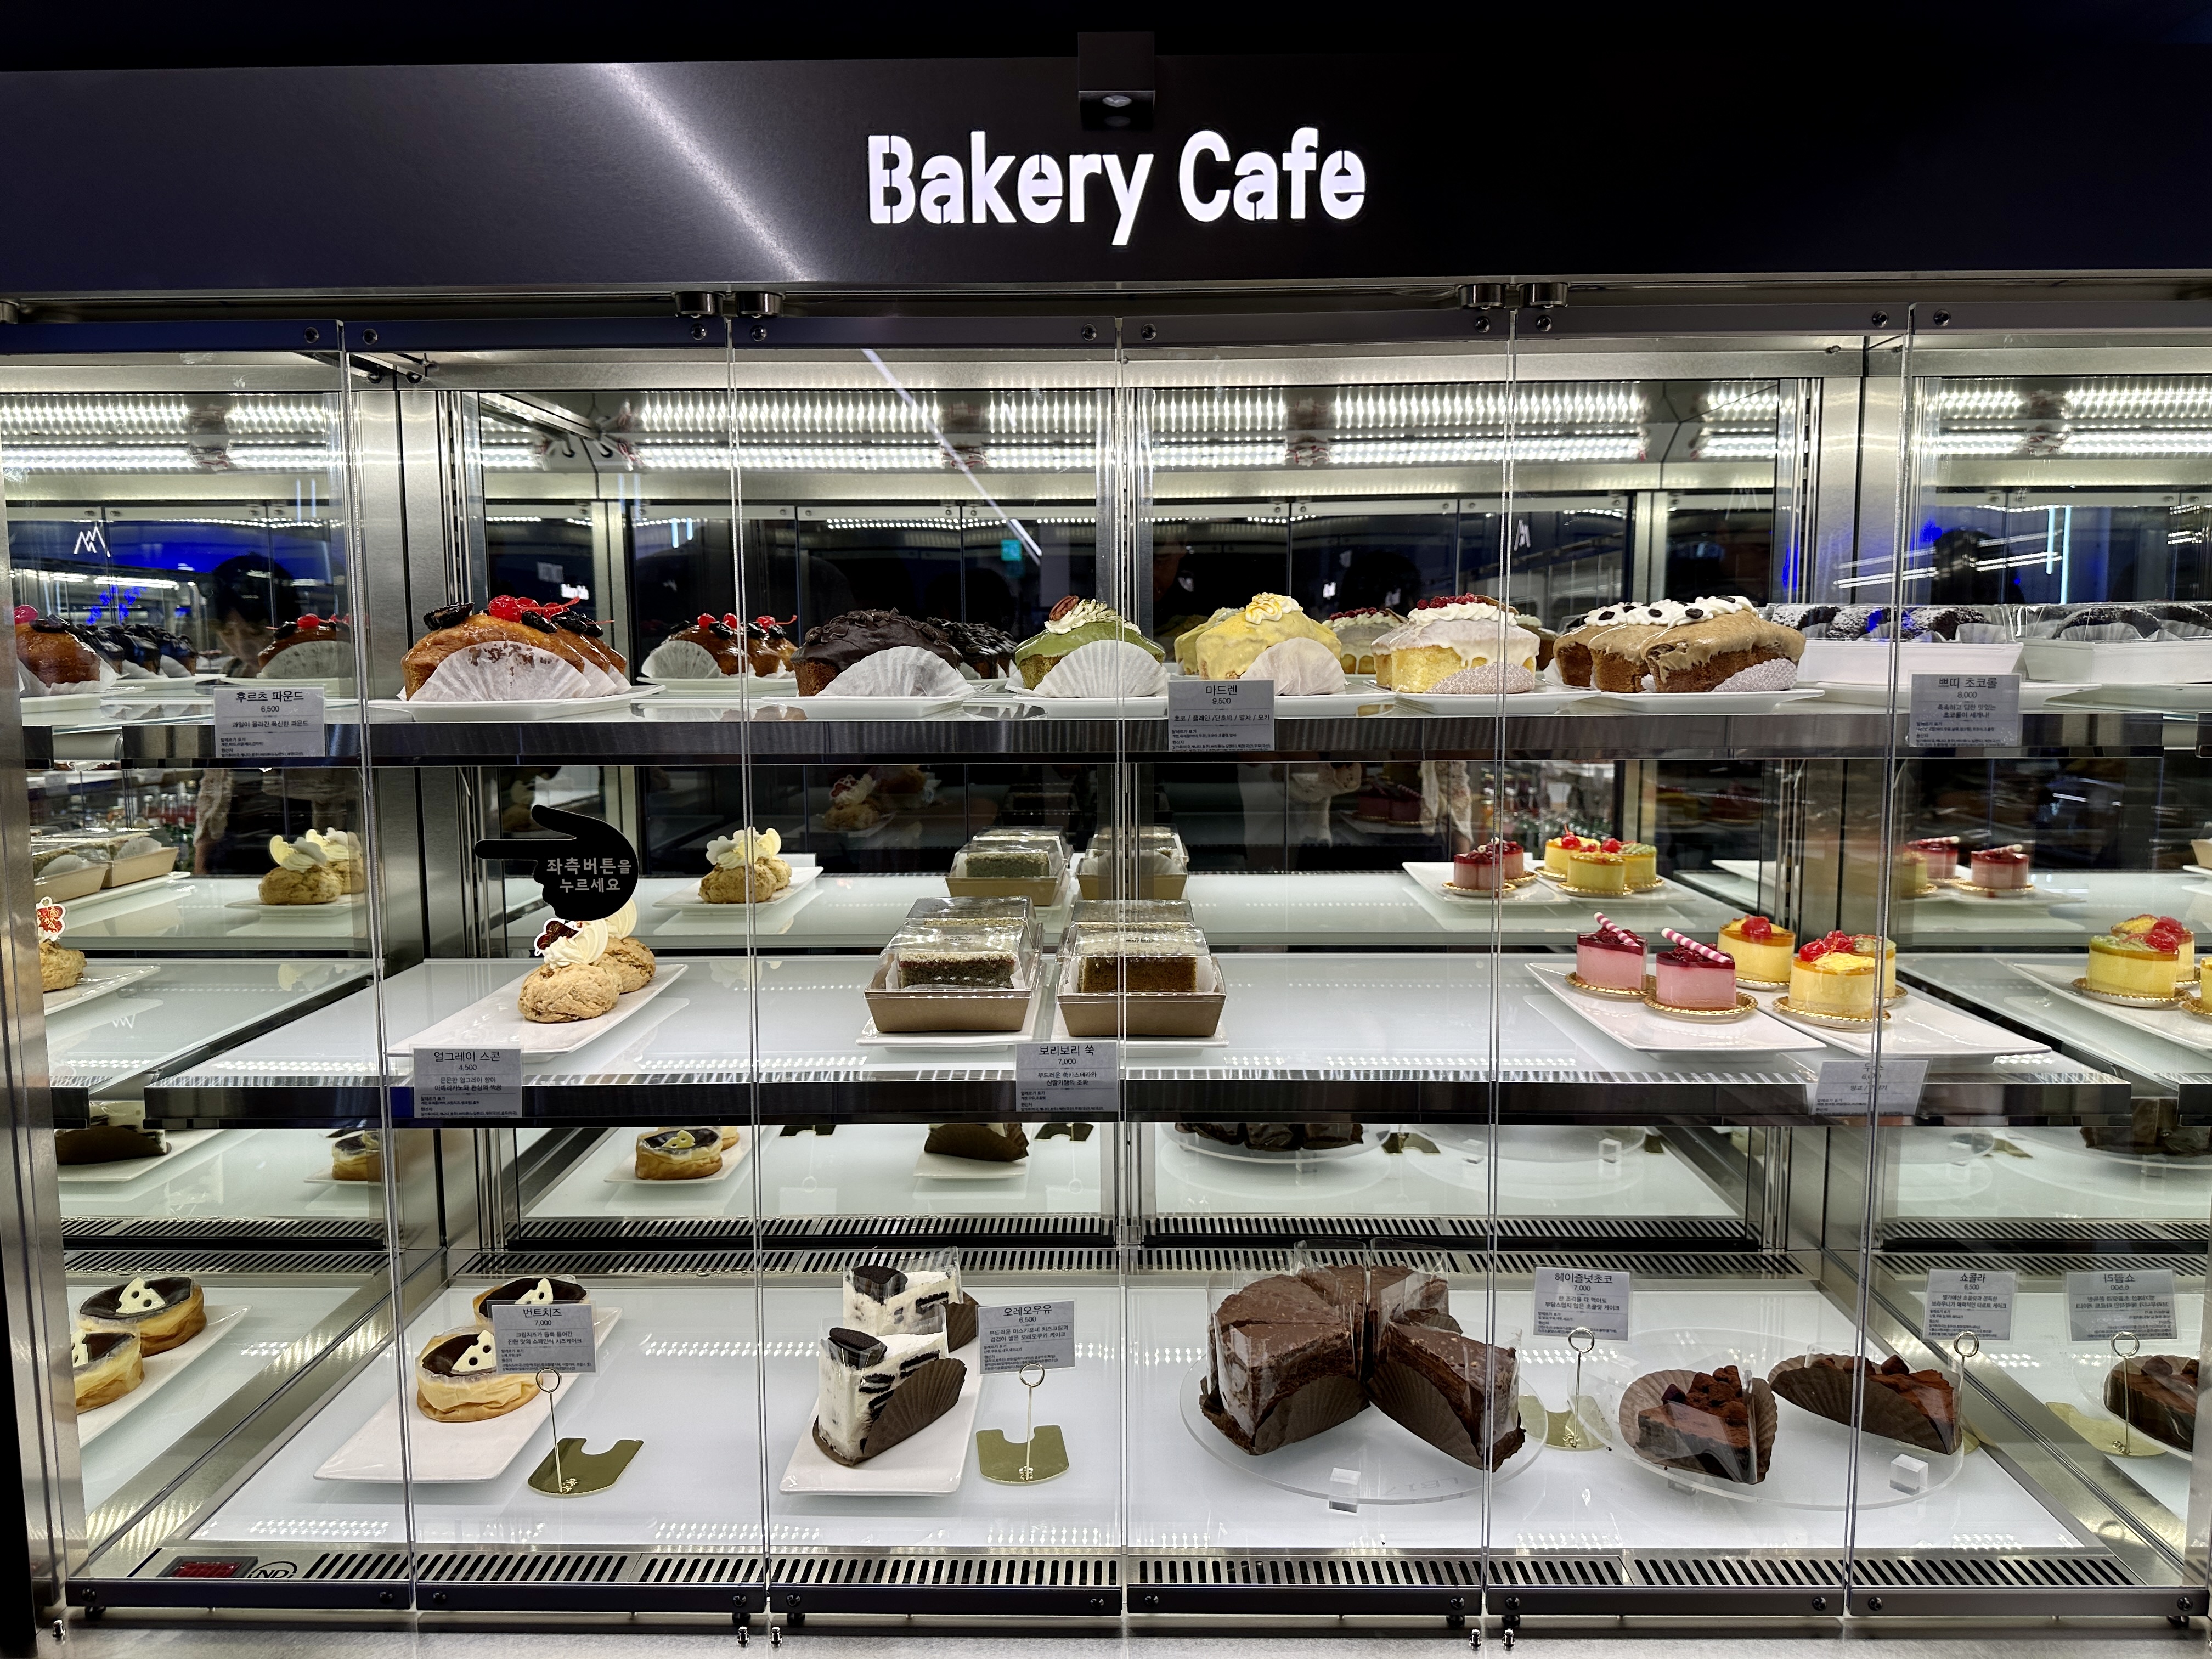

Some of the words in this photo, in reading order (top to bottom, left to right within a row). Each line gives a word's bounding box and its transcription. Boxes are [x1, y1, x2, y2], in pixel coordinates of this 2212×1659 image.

[867, 130, 1154, 246] Bakery
[1179, 127, 1366, 223] Cafe
[1938, 678, 1960, 689] 쁘띠
[1964, 678, 1997, 689] 초코롤
[1205, 685, 1238, 696] 마드렌
[235, 691, 268, 703] 후르츠
[272, 691, 304, 702] 파운드
[546, 857, 632, 876] 좌측버튼을
[559, 878, 620, 893] 누르세요
[1039, 1045, 1080, 1056] 보리보리
[1084, 1045, 1095, 1056] 쑥
[434, 1051, 476, 1062] 얼그레이
[479, 1051, 501, 1062] 스콘
[1554, 1272, 1613, 1284] 헤이즐넛초코
[1960, 1273, 1986, 1283] 쇼콜라
[523, 1308, 562, 1318] 번트치즈
[1003, 1305, 1052, 1317] 오레오우유
